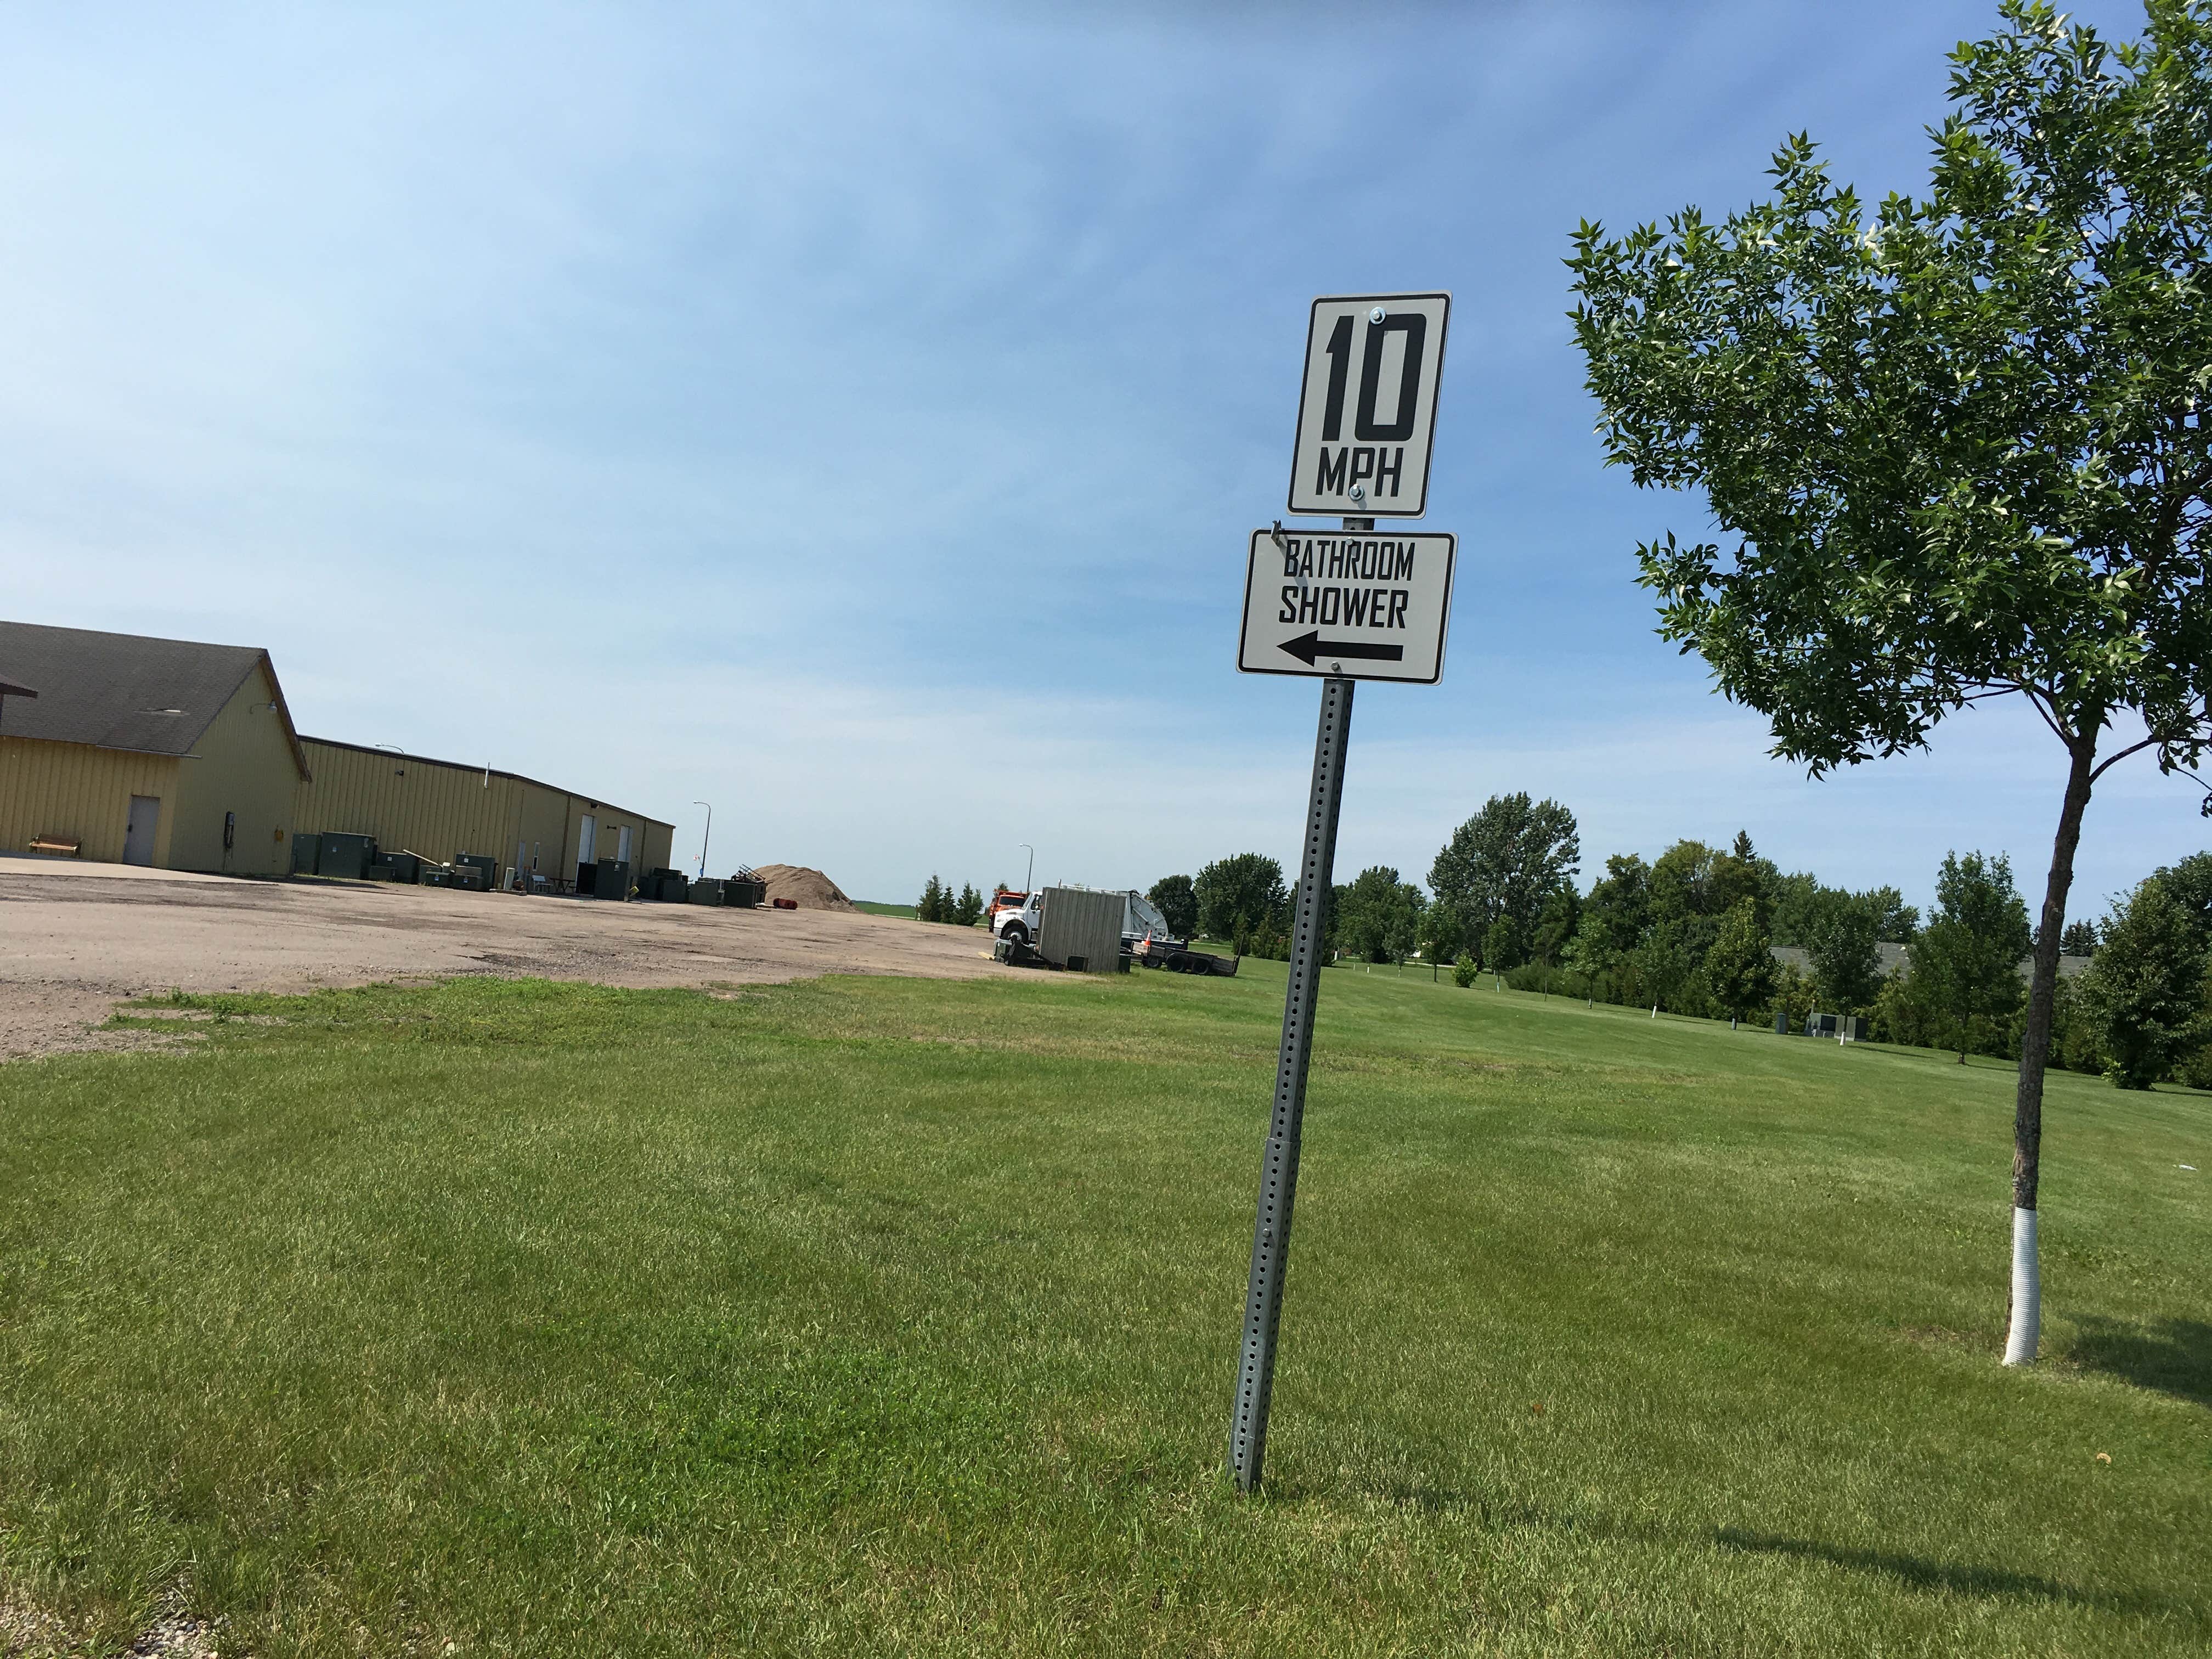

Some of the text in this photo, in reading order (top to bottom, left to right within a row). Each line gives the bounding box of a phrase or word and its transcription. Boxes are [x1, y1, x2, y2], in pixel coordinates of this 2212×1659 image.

[1322, 313, 1426, 442] 10
[1316, 447, 1403, 497] MPH
[1283, 539, 1415, 581] BATHROOM
[1279, 586, 1409, 629] SHOWER
